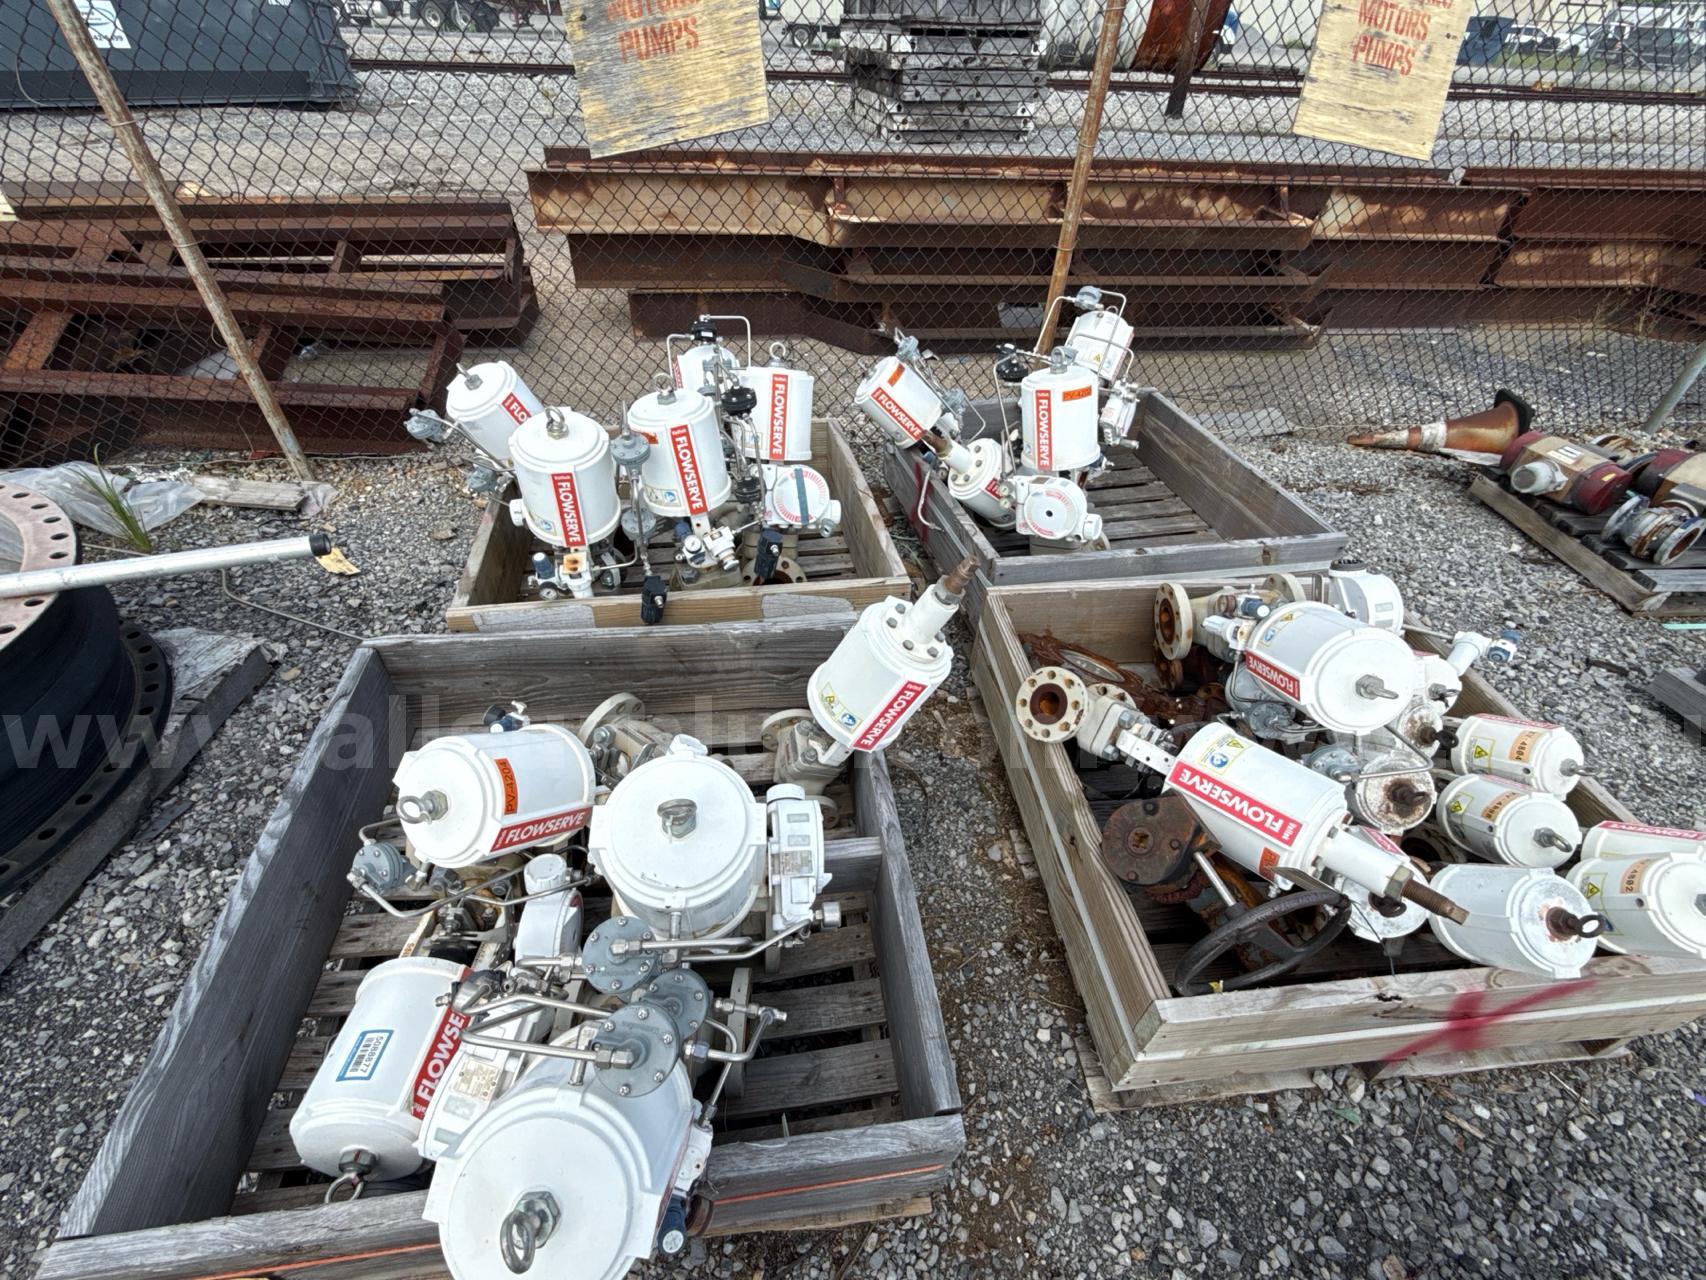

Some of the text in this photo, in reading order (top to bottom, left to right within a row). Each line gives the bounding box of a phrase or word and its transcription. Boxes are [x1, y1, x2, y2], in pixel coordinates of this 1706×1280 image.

[618, 16, 699, 63] PUMPS
[1352, 33, 1415, 76] PUMPS
[773, 384, 786, 455] FLOWSERVE
[880, 394, 922, 437] FLOWSERVE
[1039, 399, 1050, 466] FLOWSERVE
[674, 434, 703, 509] FLOWSERVE
[557, 482, 581, 543] FLOWSERVE
[1248, 656, 1294, 693] FLOWSERVE
[861, 690, 915, 745] FLOWSERVE
[498, 761, 516, 812] PV-4204
[1178, 768, 1284, 833] FLOWSERVE
[505, 812, 585, 843] FLOWSERVE
[416, 1012, 467, 1101] FLOWSE
